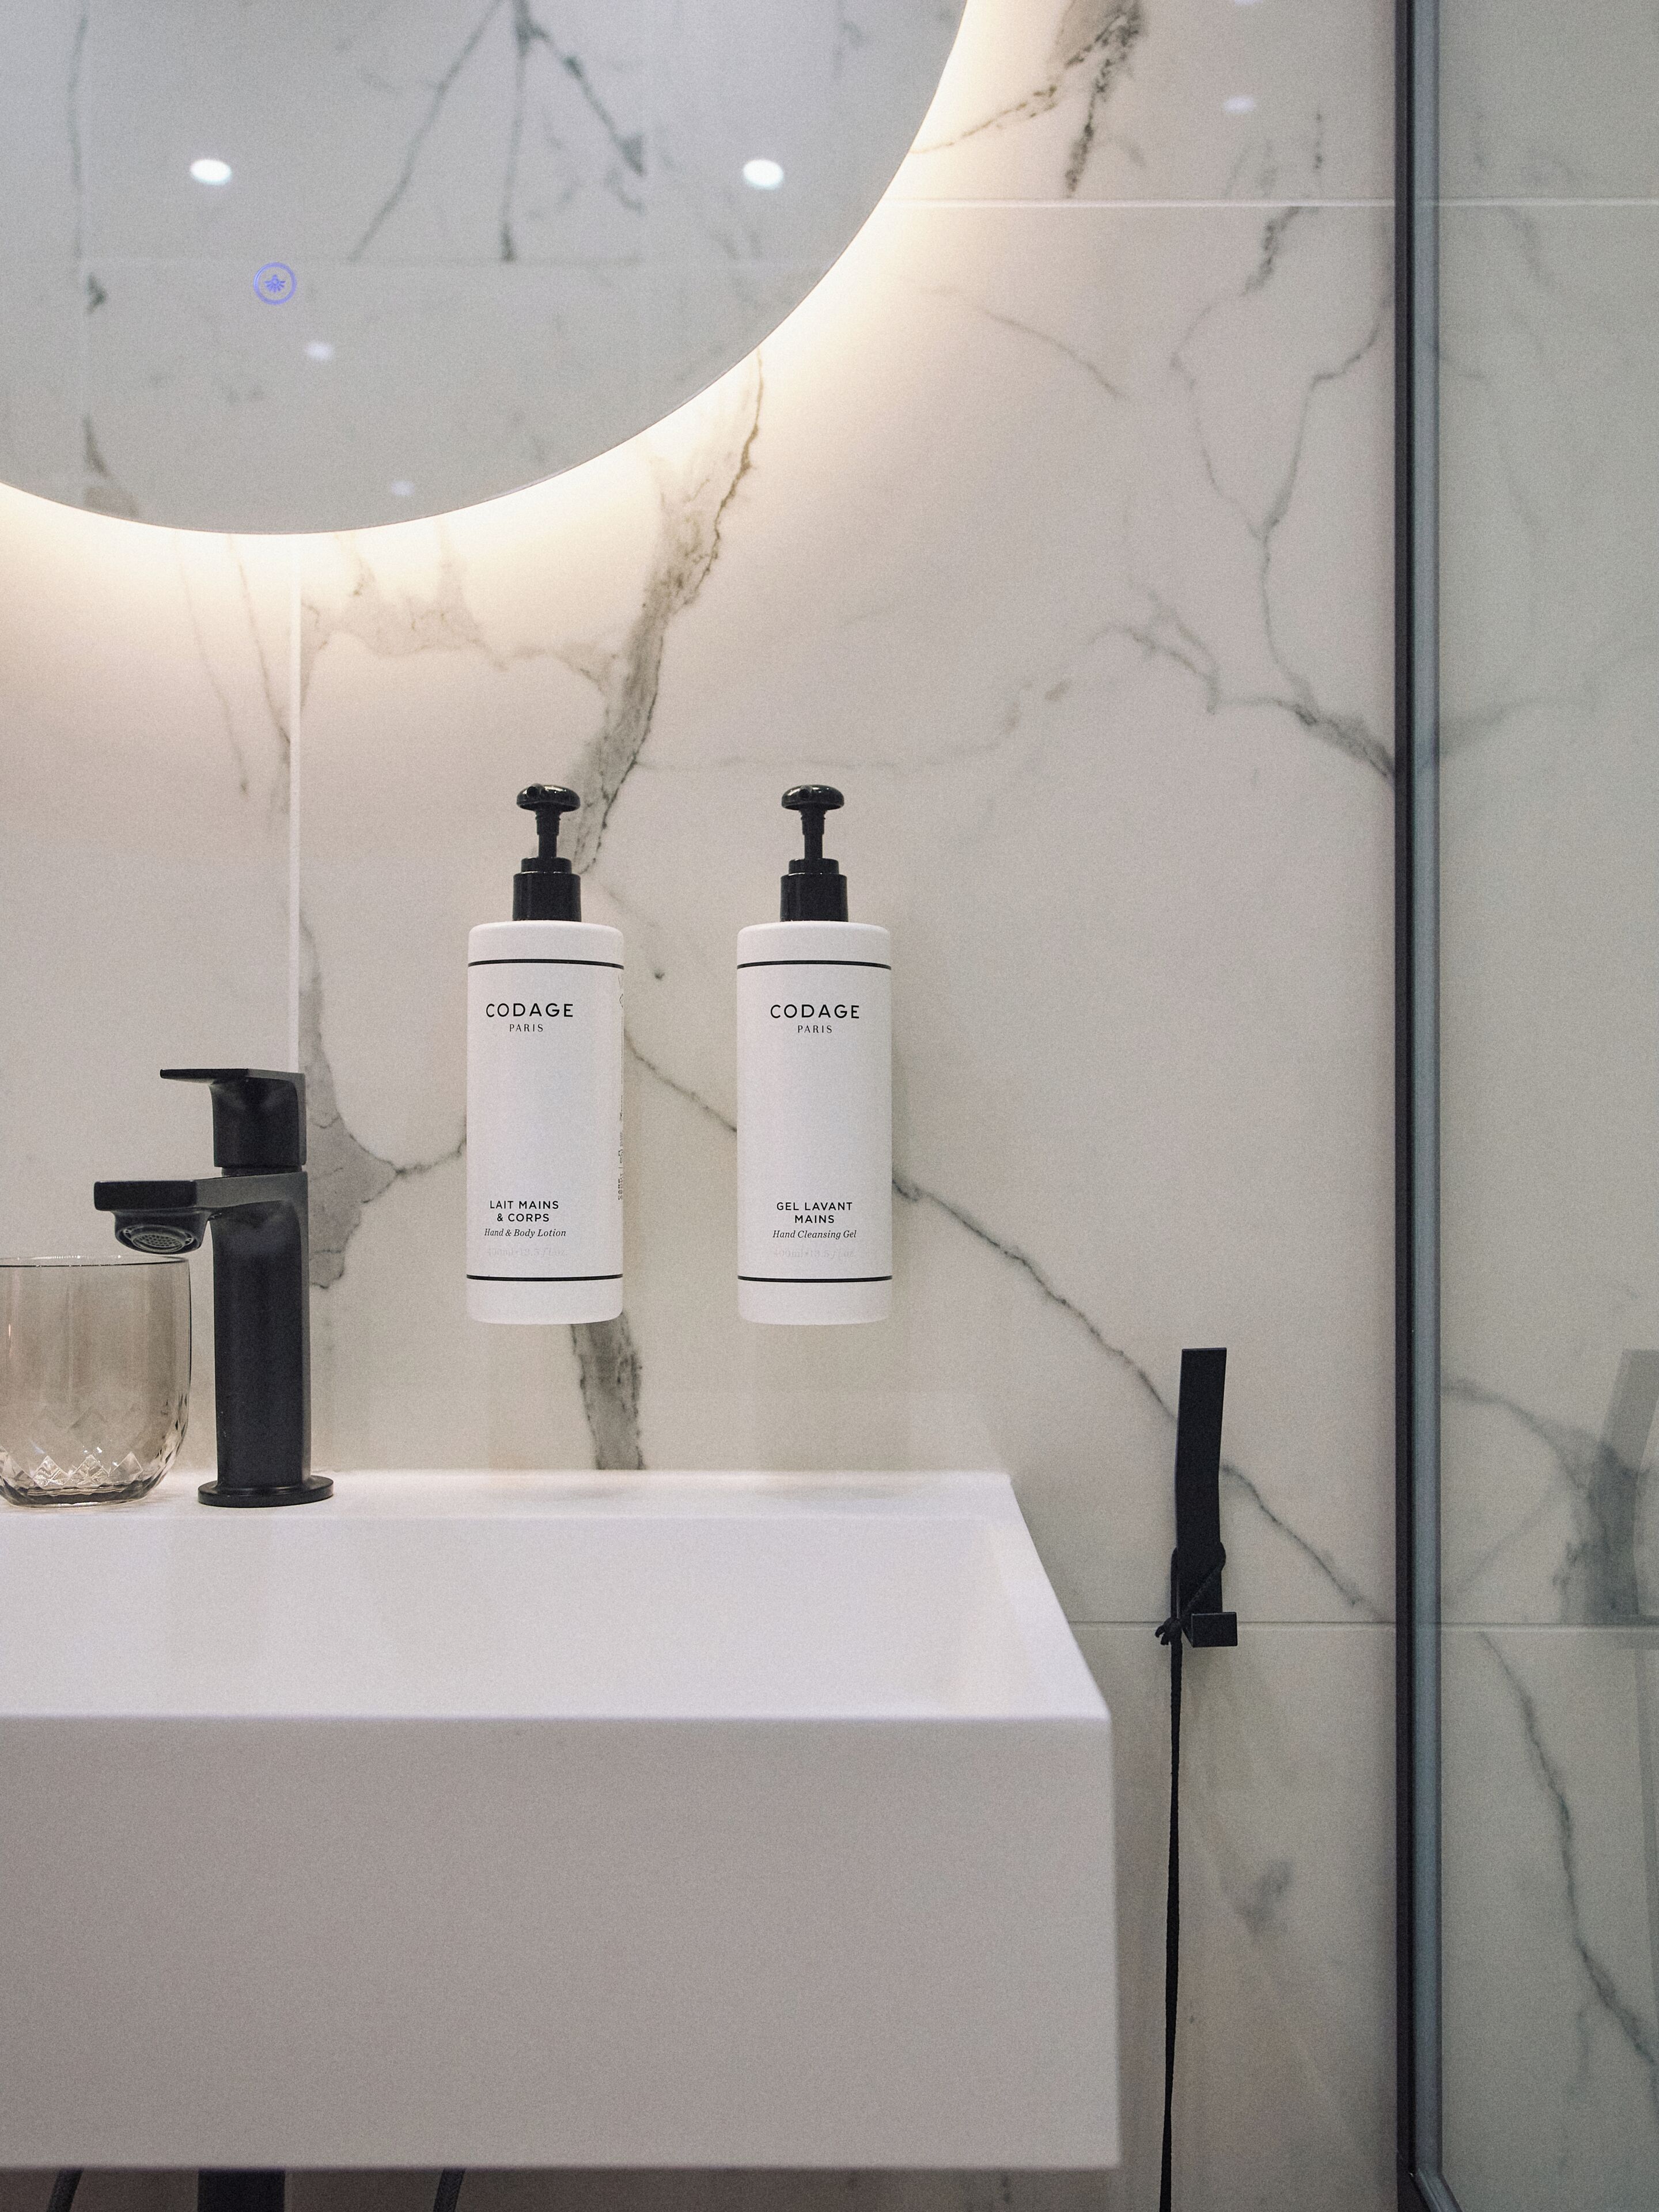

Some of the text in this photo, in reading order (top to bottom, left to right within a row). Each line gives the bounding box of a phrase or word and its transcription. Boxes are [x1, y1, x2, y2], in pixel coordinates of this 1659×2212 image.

[486, 1002, 574, 1018] CODAGE
[770, 1003, 860, 1019] CODAGE
[509, 1023, 543, 1032] PARIS
[797, 1025, 832, 1033] PARIS
[490, 1200, 559, 1210] LAIT MAINS
[777, 1202, 853, 1211] GEL LAVANT
[497, 1213, 550, 1222] & CORPS
[794, 1214, 835, 1224] MAINS
[484, 1228, 566, 1239] Hand & Body Lotion
[772, 1229, 857, 1240] Hand Cleansing Gel
